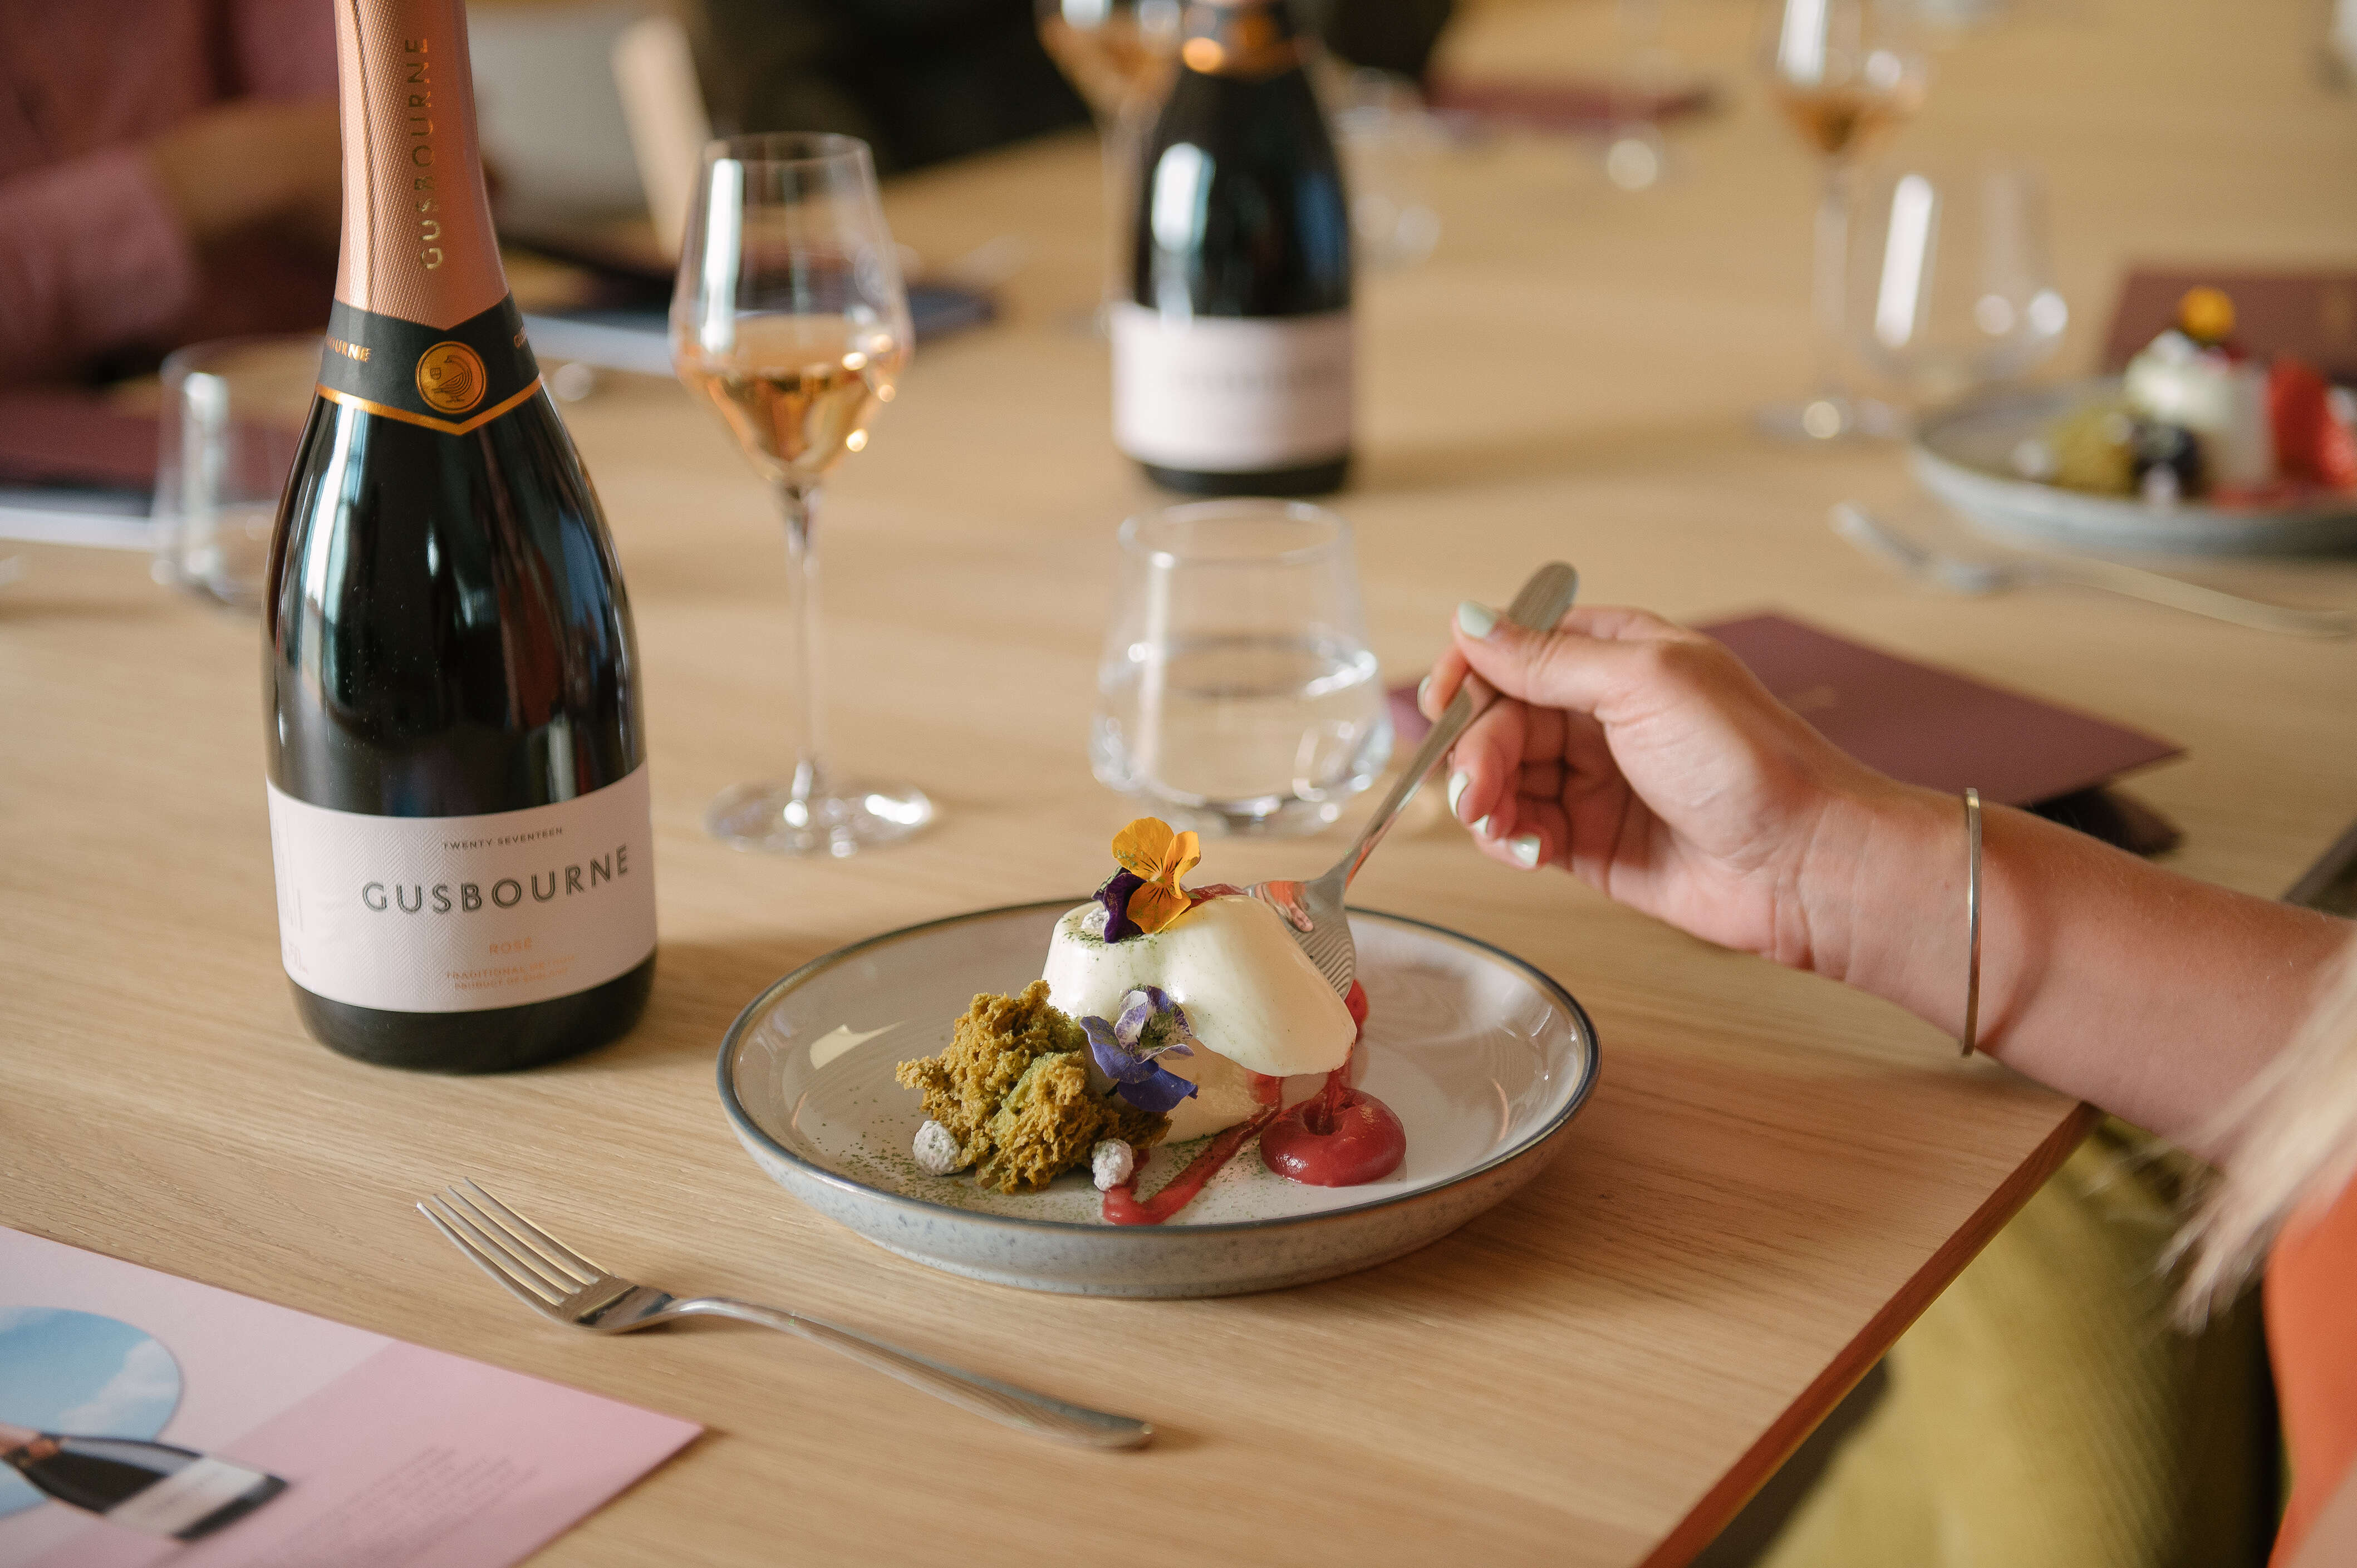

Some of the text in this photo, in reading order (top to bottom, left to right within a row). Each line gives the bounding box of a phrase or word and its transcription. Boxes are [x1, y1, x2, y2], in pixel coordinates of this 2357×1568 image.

[405, 38, 443, 270] GUSBOURNE
[326, 335, 372, 363] OURNE
[444, 828, 562, 850] TWENTY SEVENTEEN
[361, 844, 628, 915] GUSBOURNE
